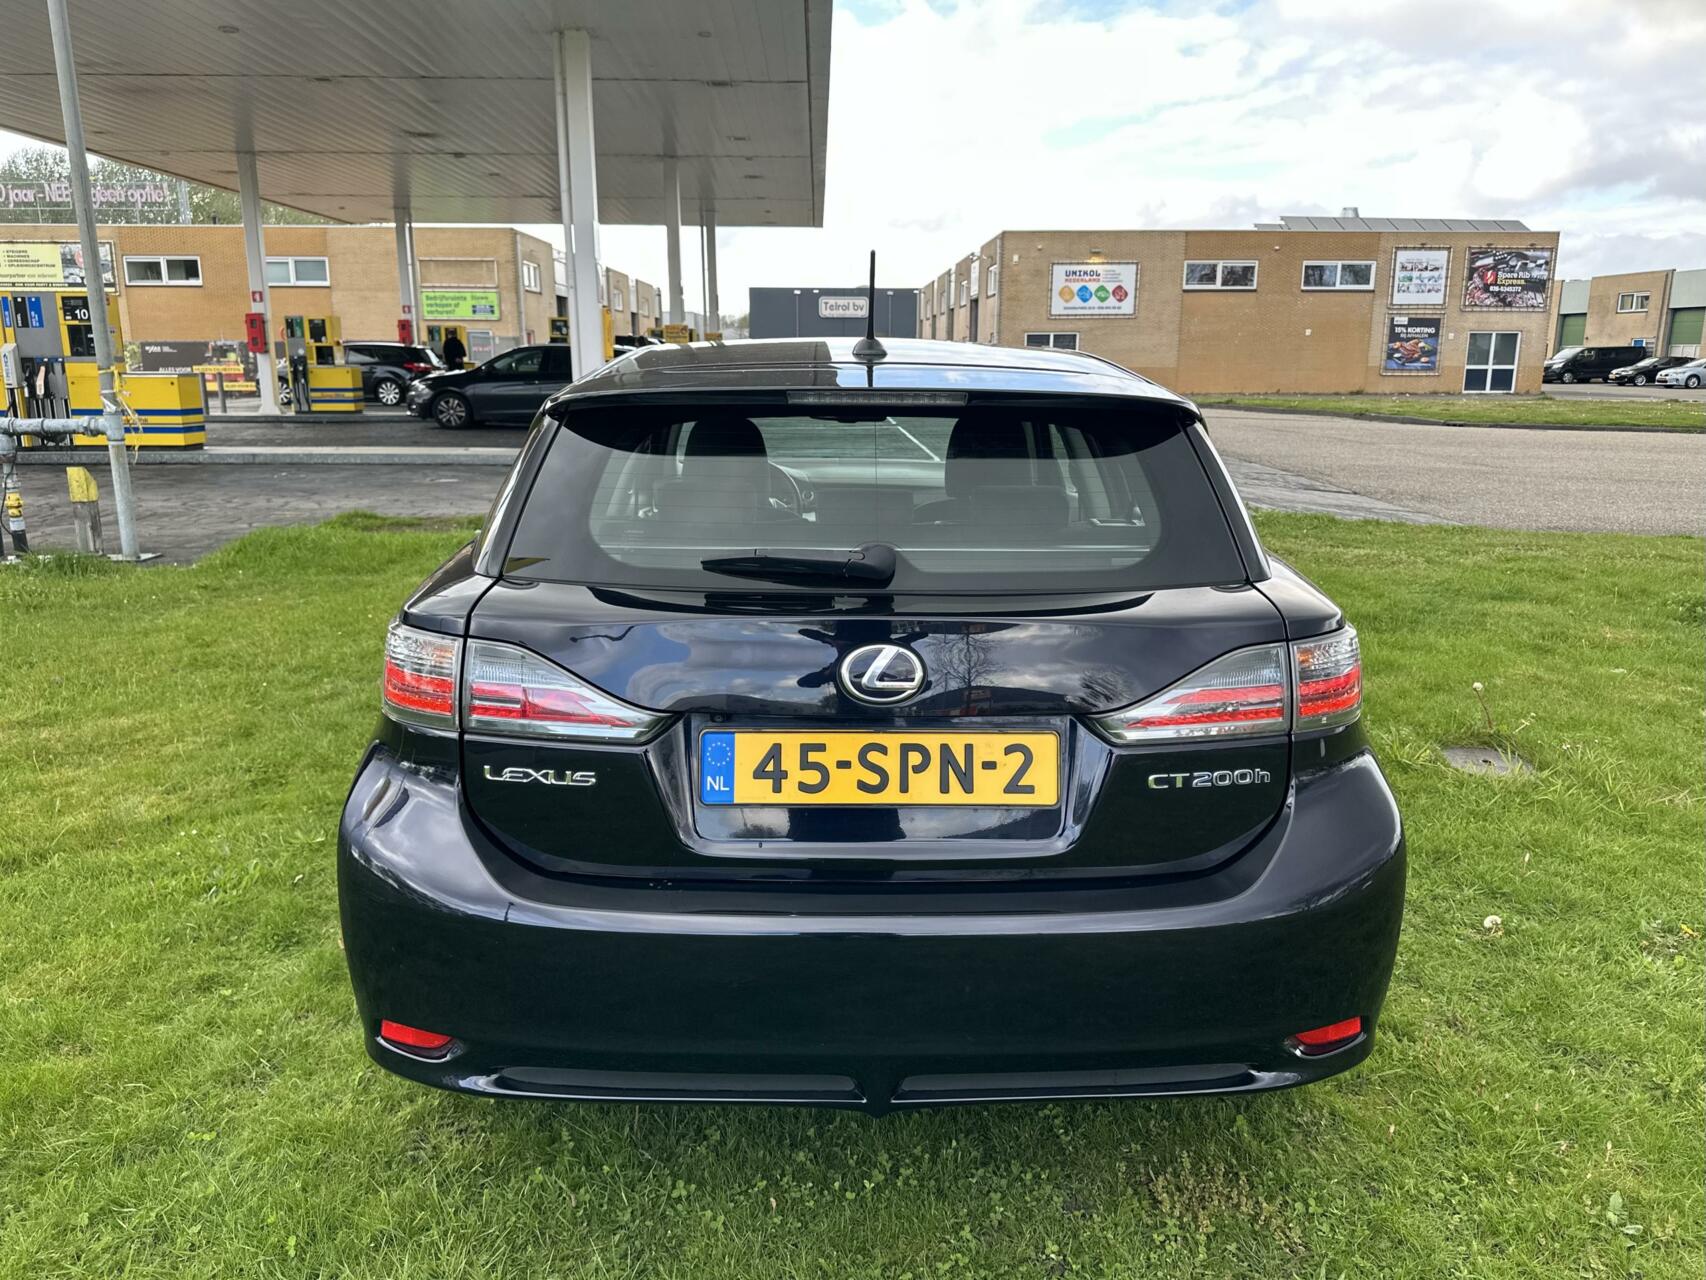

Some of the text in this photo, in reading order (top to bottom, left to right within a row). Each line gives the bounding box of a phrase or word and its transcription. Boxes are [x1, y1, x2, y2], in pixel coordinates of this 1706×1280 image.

[8, 184, 36, 208] jaar
[1498, 271, 1530, 280] Spare Rib
[823, 301, 864, 311] Telrol bv
[75, 309, 89, 320] 10
[483, 765, 596, 786] LEXUS
[752, 742, 1036, 795] 45-SPN-2
[706, 776, 730, 791] NL
